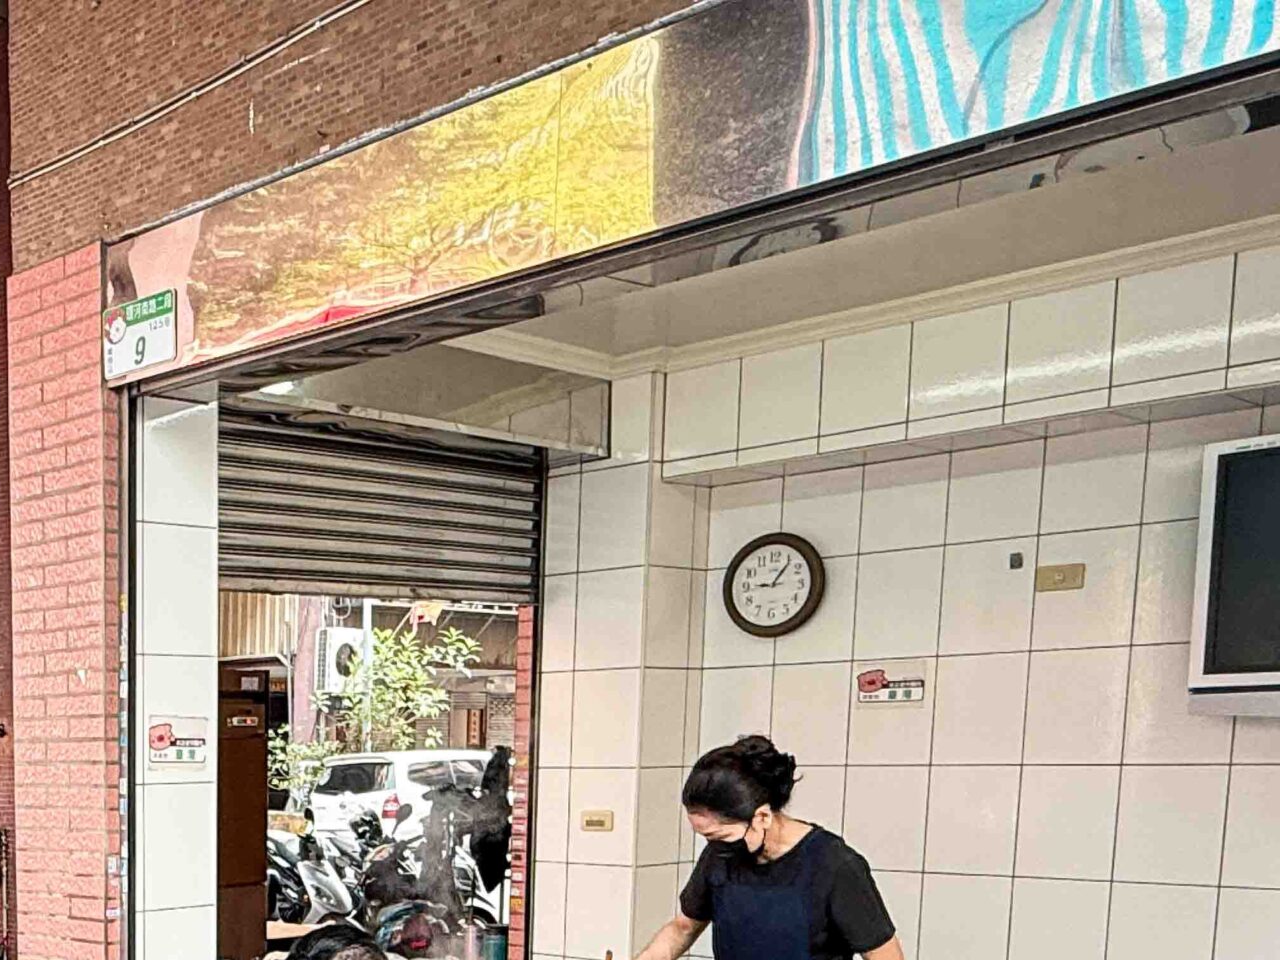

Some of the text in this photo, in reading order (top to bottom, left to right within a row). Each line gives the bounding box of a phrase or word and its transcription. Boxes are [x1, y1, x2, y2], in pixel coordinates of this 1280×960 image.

[134, 335, 147, 366] 9
[757, 555, 767, 568] 11
[770, 551, 782, 564] 12
[741, 581, 751, 594] 9
[755, 604, 762, 617] 7
[767, 607, 776, 619] 6
